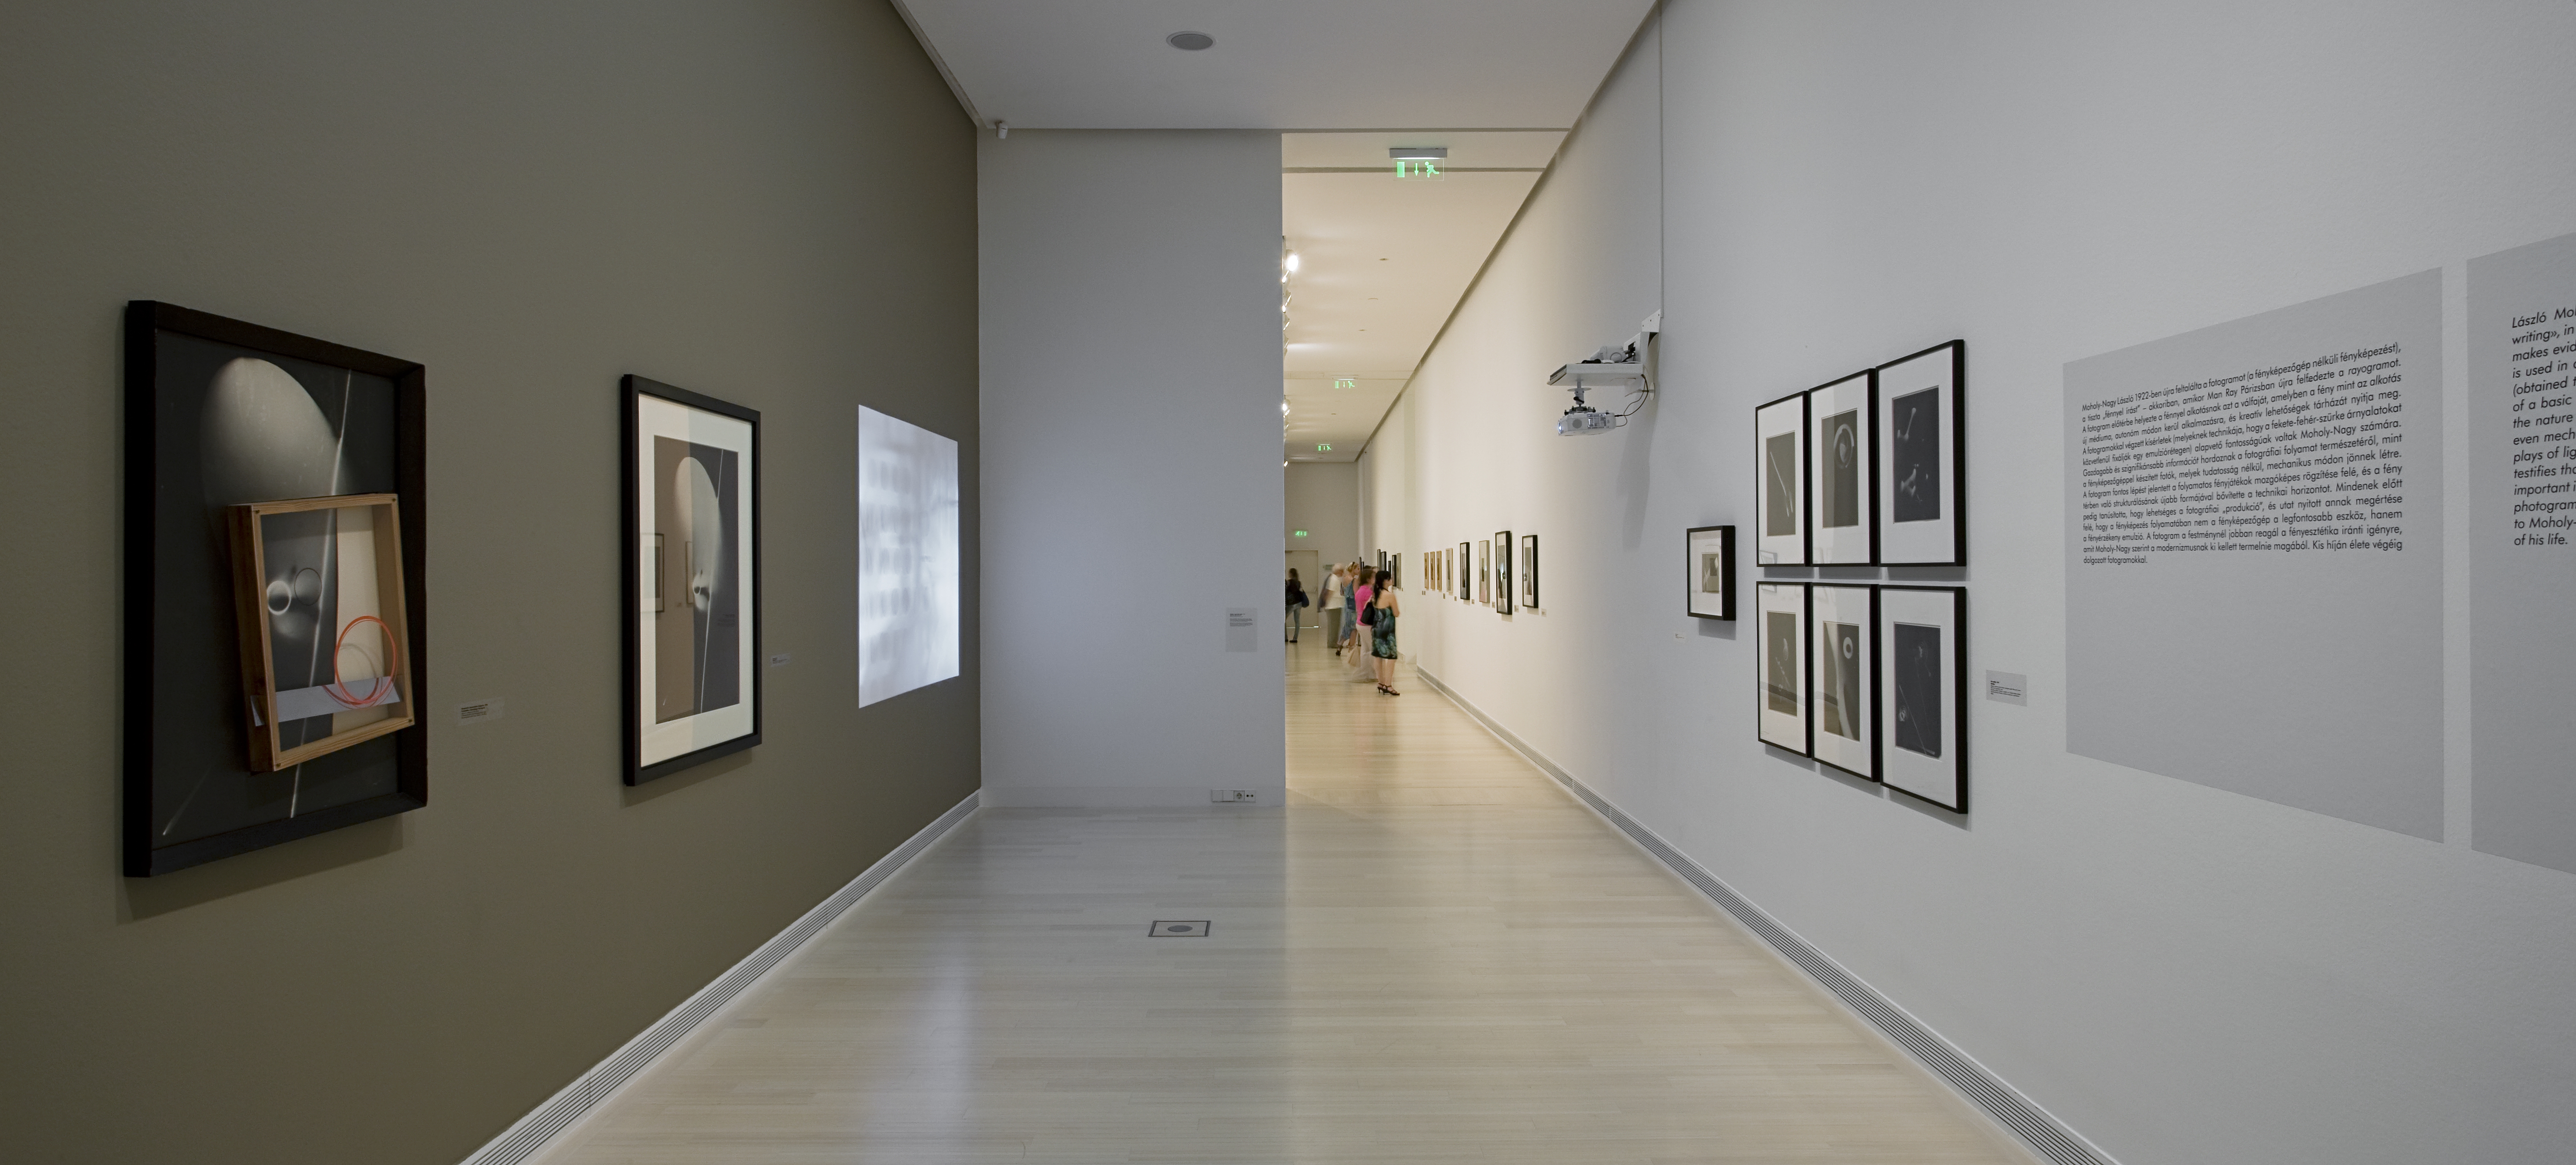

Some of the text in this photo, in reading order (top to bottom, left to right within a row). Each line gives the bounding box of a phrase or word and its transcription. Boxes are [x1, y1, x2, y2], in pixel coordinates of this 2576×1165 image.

[2512, 312, 2546, 328] László
[2512, 324, 2574, 345] writing», in
[2513, 347, 2548, 362] makes
[2082, 400, 2117, 411] Moholy-Nagy
[2117, 395, 2134, 405] László
[2135, 390, 2162, 401] 1922-ben
[2163, 387, 2174, 397] újra
[2175, 382, 2202, 393] feltalálta
[2208, 374, 2246, 387] fotogramot
[2247, 371, 2253, 382] (a
[2255, 361, 2311, 378] fényképezőgép
[2313, 354, 2338, 367] nélküli
[2340, 342, 2401, 362] fényképezést),
[2513, 368, 2520, 378] is
[2526, 361, 2552, 376] used
[2558, 360, 2567, 371] in
[2149, 399, 2179, 410] akkoriban,
[2183, 394, 2205, 404] amikor
[2207, 391, 2222, 400] Man
[2225, 388, 2238, 397] Ray
[2241, 382, 2275, 394] Párizsban
[2278, 378, 2293, 389] újra
[2296, 371, 2335, 384] felfedezte
[2348, 358, 2401, 376] rayogramot.
[2513, 376, 2568, 397] (obtained
[2513, 399, 2525, 412] of
[2541, 395, 2572, 408] basic
[2082, 390, 2401, 446] új médiuma, autonóm módon kerül alkalmazásra, és kreatív lehetőségek tárházát nyitja meg.
[2514, 414, 2573, 428] the nature
[2087, 442, 2124, 455] fotogramokkal
[2125, 440, 2144, 450] végzett
[2145, 435, 2172, 446] kísérletek
[2173, 430, 2207, 444] (melyeknek
[2208, 426, 2244, 437] technikája,
[2246, 424, 2264, 434] hogy
[2271, 412, 2345, 429] fekete-fehér-szürke
[2346, 403, 2402, 419] árnyalatokat
[2514, 435, 2539, 445] even
[2083, 466, 2113, 477] Gazdagabb
[2122, 460, 2164, 474] szignifikánsabb
[2165, 457, 2199, 467] információt
[2201, 452, 2236, 463] hordoznak
[2244, 446, 2281, 460] fotográfiai
[2284, 444, 2318, 456] folyamat
[2320, 435, 2379, 451] természetéről,
[2382, 433, 2402, 444] mint
[2514, 450, 2543, 465] plays
[2547, 446, 2559, 458] of
[2088, 475, 2134, 487] fényképezőgéppel
[2160, 471, 2177, 480] fotók,
[2179, 468, 2201, 479] melyek
[2202, 466, 2238, 476] tudatosság
[2241, 462, 2264, 472] nélkül,
[2267, 458, 2311, 469] mechanikus
[2314, 454, 2343, 465] módon
[2346, 450, 2376, 464] jönnek
[2380, 449, 2402, 459] létre.
[2514, 465, 2556, 478] testifies
[2088, 490, 2111, 499] fotogram
[2130, 486, 2147, 496] lépést
[2148, 484, 2171, 495] jelentett
[2178, 481, 2212, 491] folyamatos
[2214, 476, 2252, 489] fényjátékok
[2255, 474, 2300, 485] mozgóképes
[2303, 470, 2338, 482] rögzítése
[2341, 467, 2358, 477] felé,
[2362, 466, 2371, 475] és
[2383, 463, 2402, 475] fény
[2514, 482, 2570, 497] important
[2100, 500, 2111, 508] való
[2113, 496, 2158, 507] strukturálásának
[2161, 495, 2178, 505] újabb
[2180, 492, 2213, 503] formájával
[2216, 491, 2245, 500] bővítette
[2255, 487, 2287, 497] technikai
[2291, 485, 2332, 495] horizontot.
[2336, 479, 2379, 491] Mindenek
[2382, 478, 2403, 489] előtt
[2083, 512, 2097, 521] pedig
[2130, 510, 2144, 519] hogy
[2146, 508, 2176, 517] lehetséges
[2186, 504, 2219, 516] fotográfiai
[2268, 502, 2276, 510] és
[2279, 501, 2294, 509] utat
[2298, 499, 2321, 510] nyitott
[2325, 496, 2351, 507] annak
[2356, 494, 2402, 507] megértése
[2083, 523, 2094, 531] felé,
[2095, 523, 2108, 532] hogy
[2116, 521, 2148, 531] fényképezés
[2150, 519, 2191, 530] folyamatában
[2218, 515, 2270, 527] fényképezőgép
[2282, 512, 2332, 525] legfontosabb
[2336, 510, 2366, 521] eszköz,
[2371, 509, 2402, 519] hanem
[2514, 519, 2525, 529] to
[2514, 533, 2568, 545] of his life.
[2107, 555, 2148, 565] fotogramokkal.
